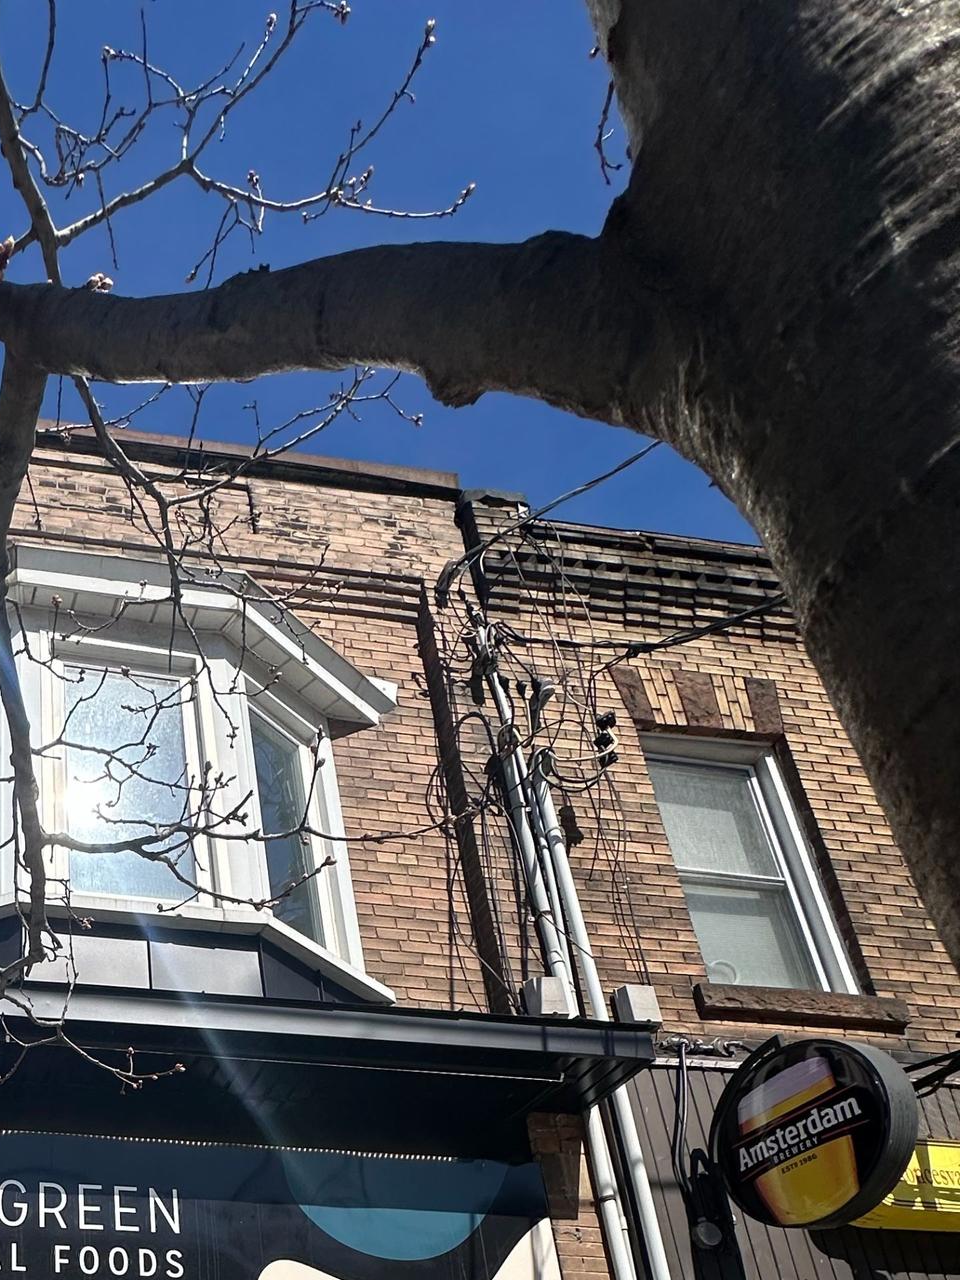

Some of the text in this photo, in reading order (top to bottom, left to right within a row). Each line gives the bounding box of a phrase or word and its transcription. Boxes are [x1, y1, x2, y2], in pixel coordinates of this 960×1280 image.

[739, 1096, 862, 1172] Amsterdam
[773, 1137, 819, 1164] BREWERY
[54, 1245, 185, 1279] FOODS
